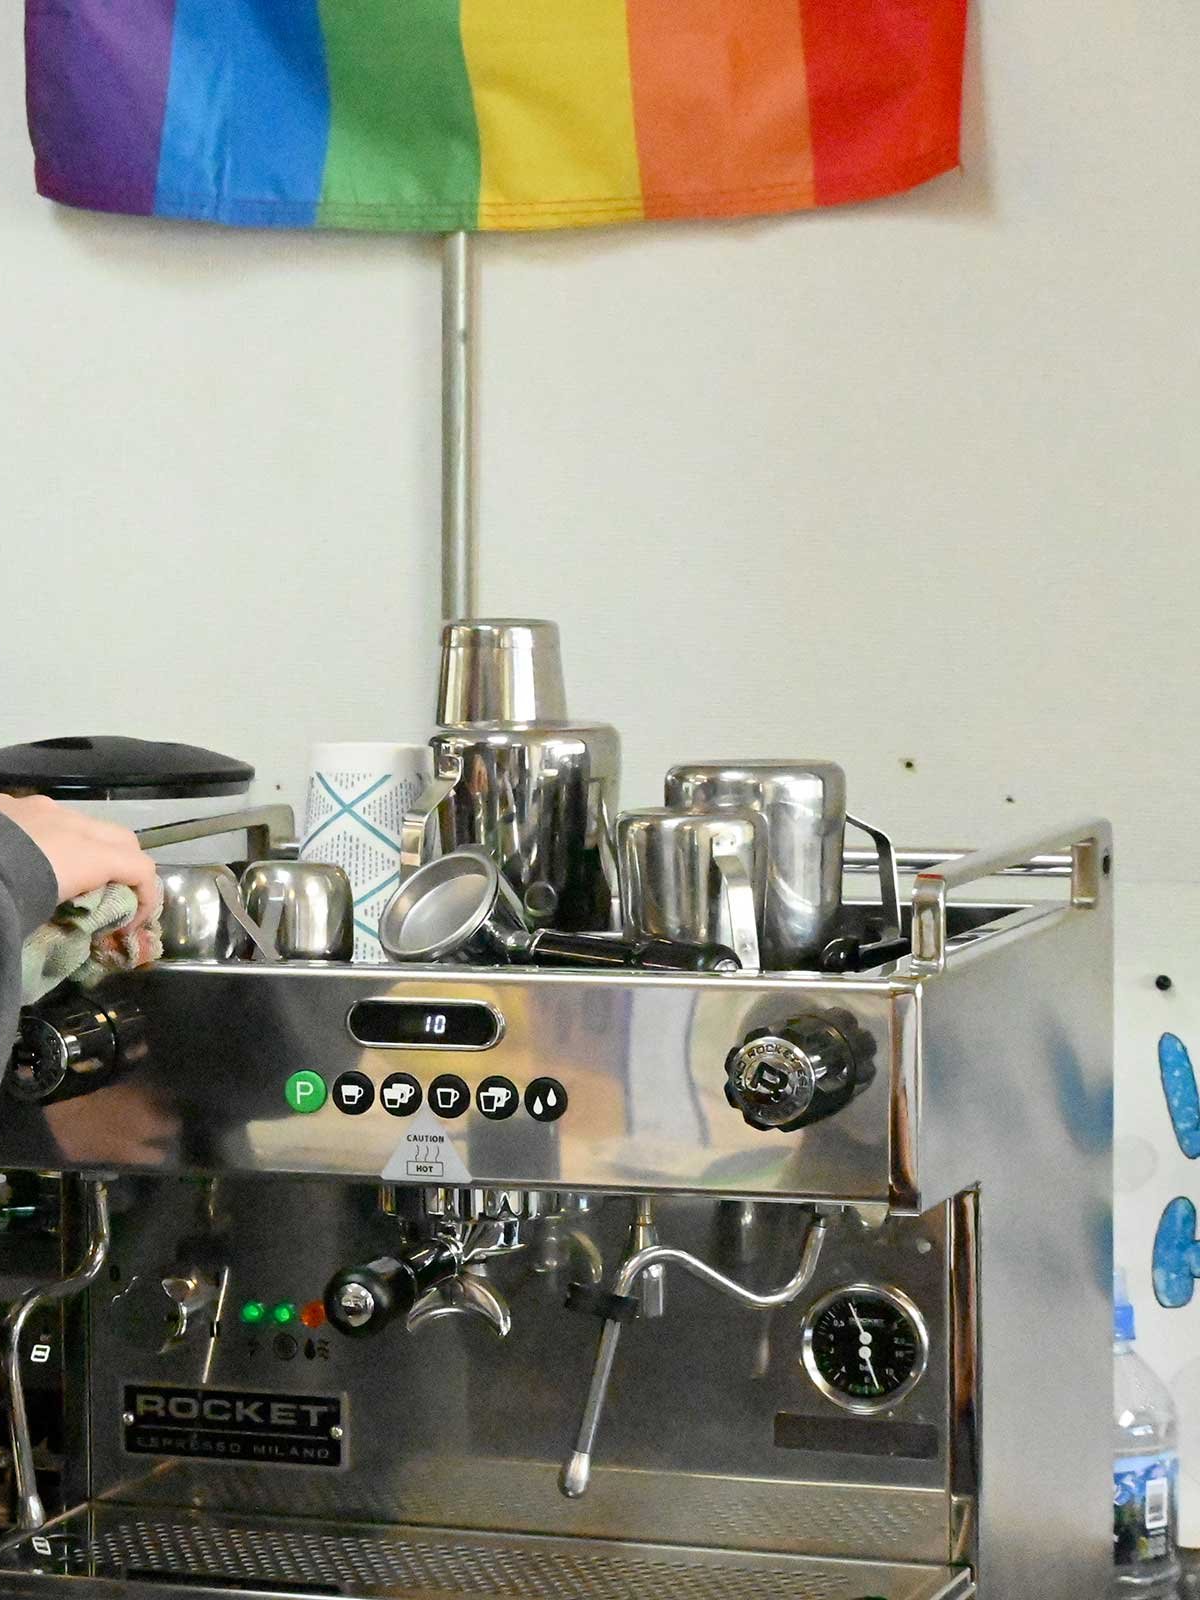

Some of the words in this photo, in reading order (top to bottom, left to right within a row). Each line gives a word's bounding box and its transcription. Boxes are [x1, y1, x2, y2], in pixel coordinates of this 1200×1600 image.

[425, 1014, 446, 1035] 10
[296, 1081, 314, 1105] P
[406, 1134, 445, 1144] CAUTION
[415, 1164, 434, 1174] HOT
[135, 1393, 330, 1427] ROCKET
[253, 1443, 330, 1459] MILANO
